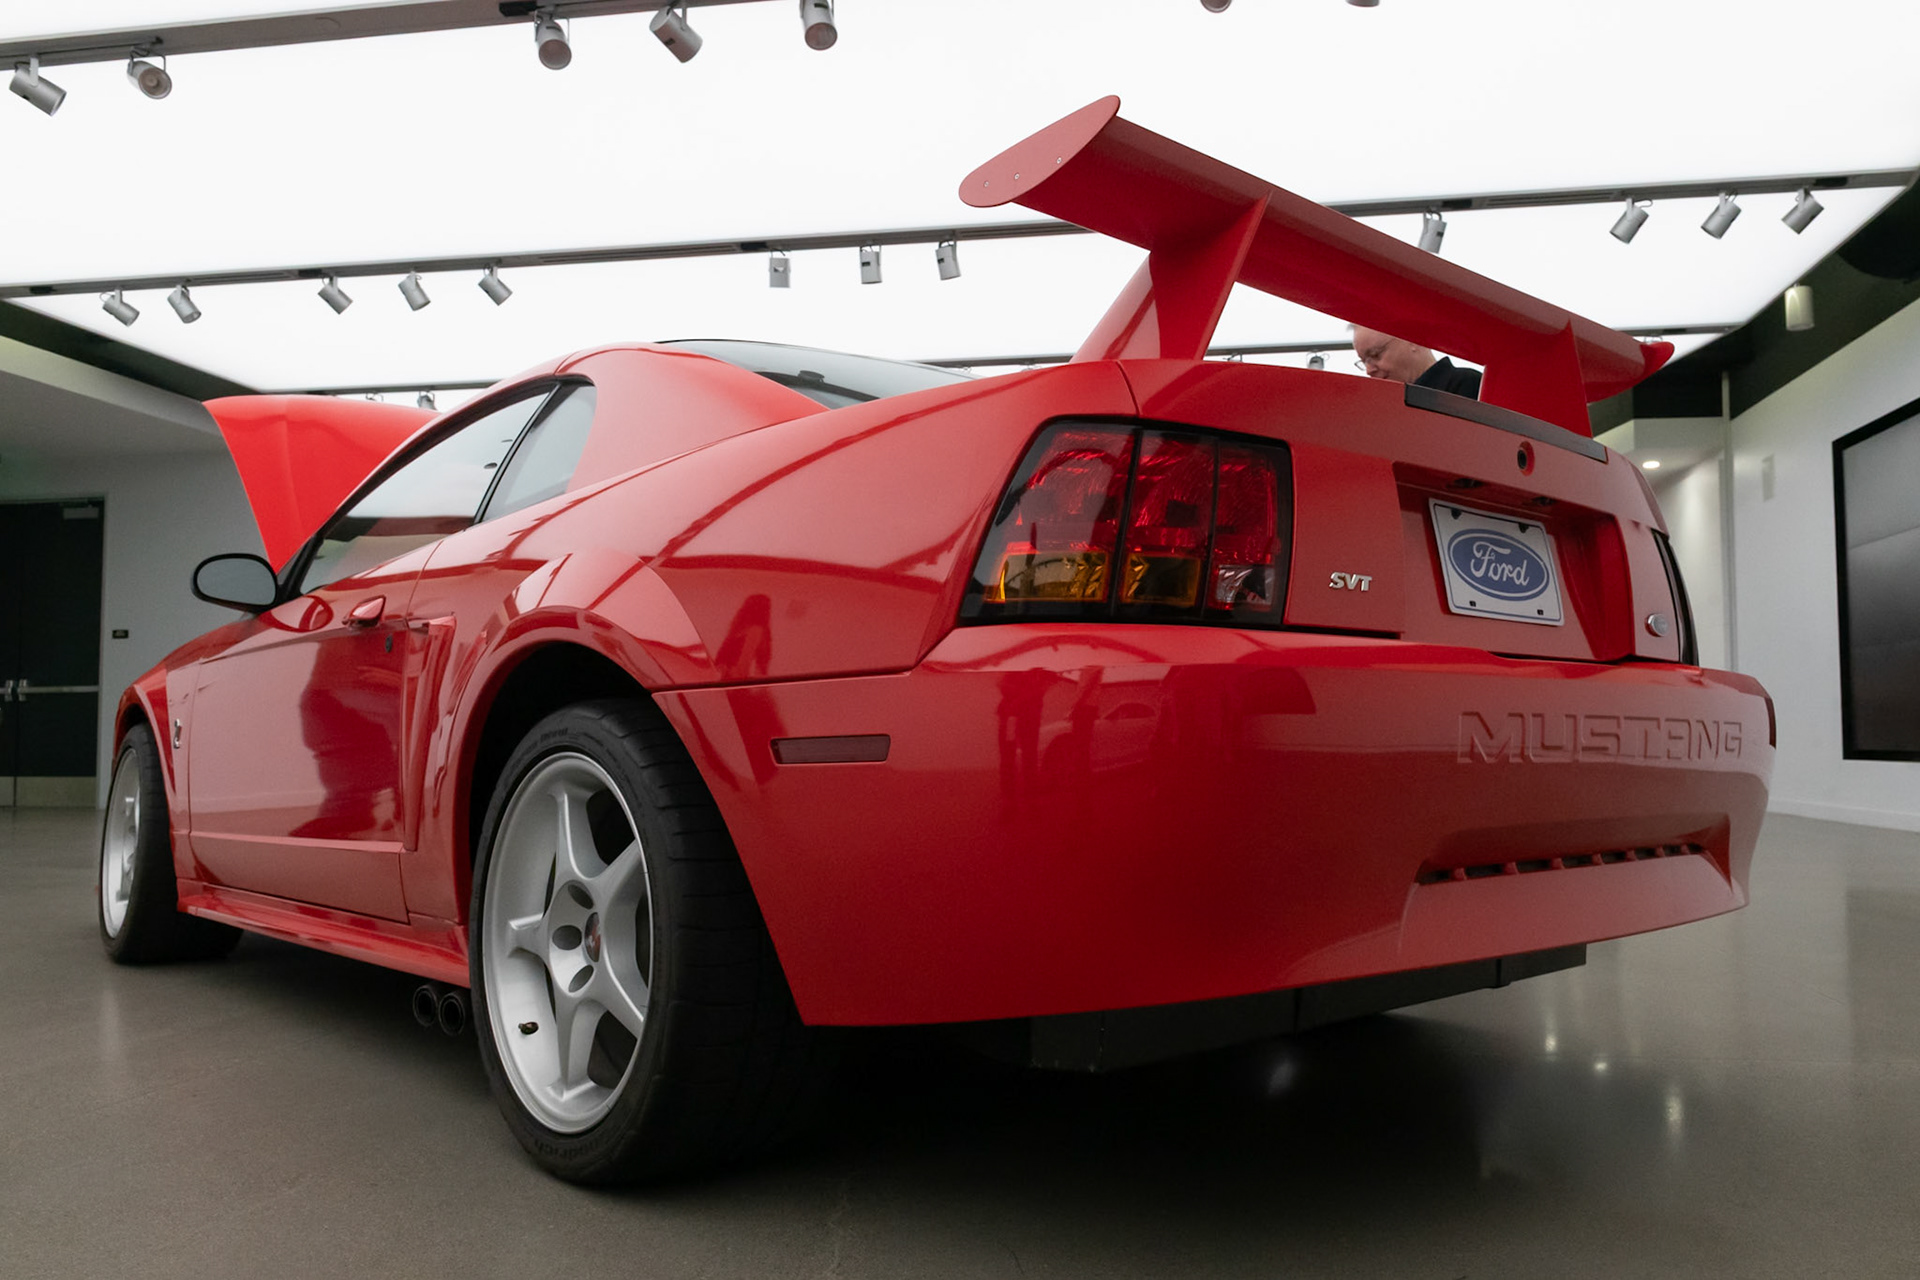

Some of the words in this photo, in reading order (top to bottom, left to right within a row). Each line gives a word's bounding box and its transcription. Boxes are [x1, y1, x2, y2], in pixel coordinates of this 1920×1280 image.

[1329, 571, 1372, 592] SVT
[1470, 541, 1530, 586] Ford
[1456, 711, 1742, 763] MUSTANG
